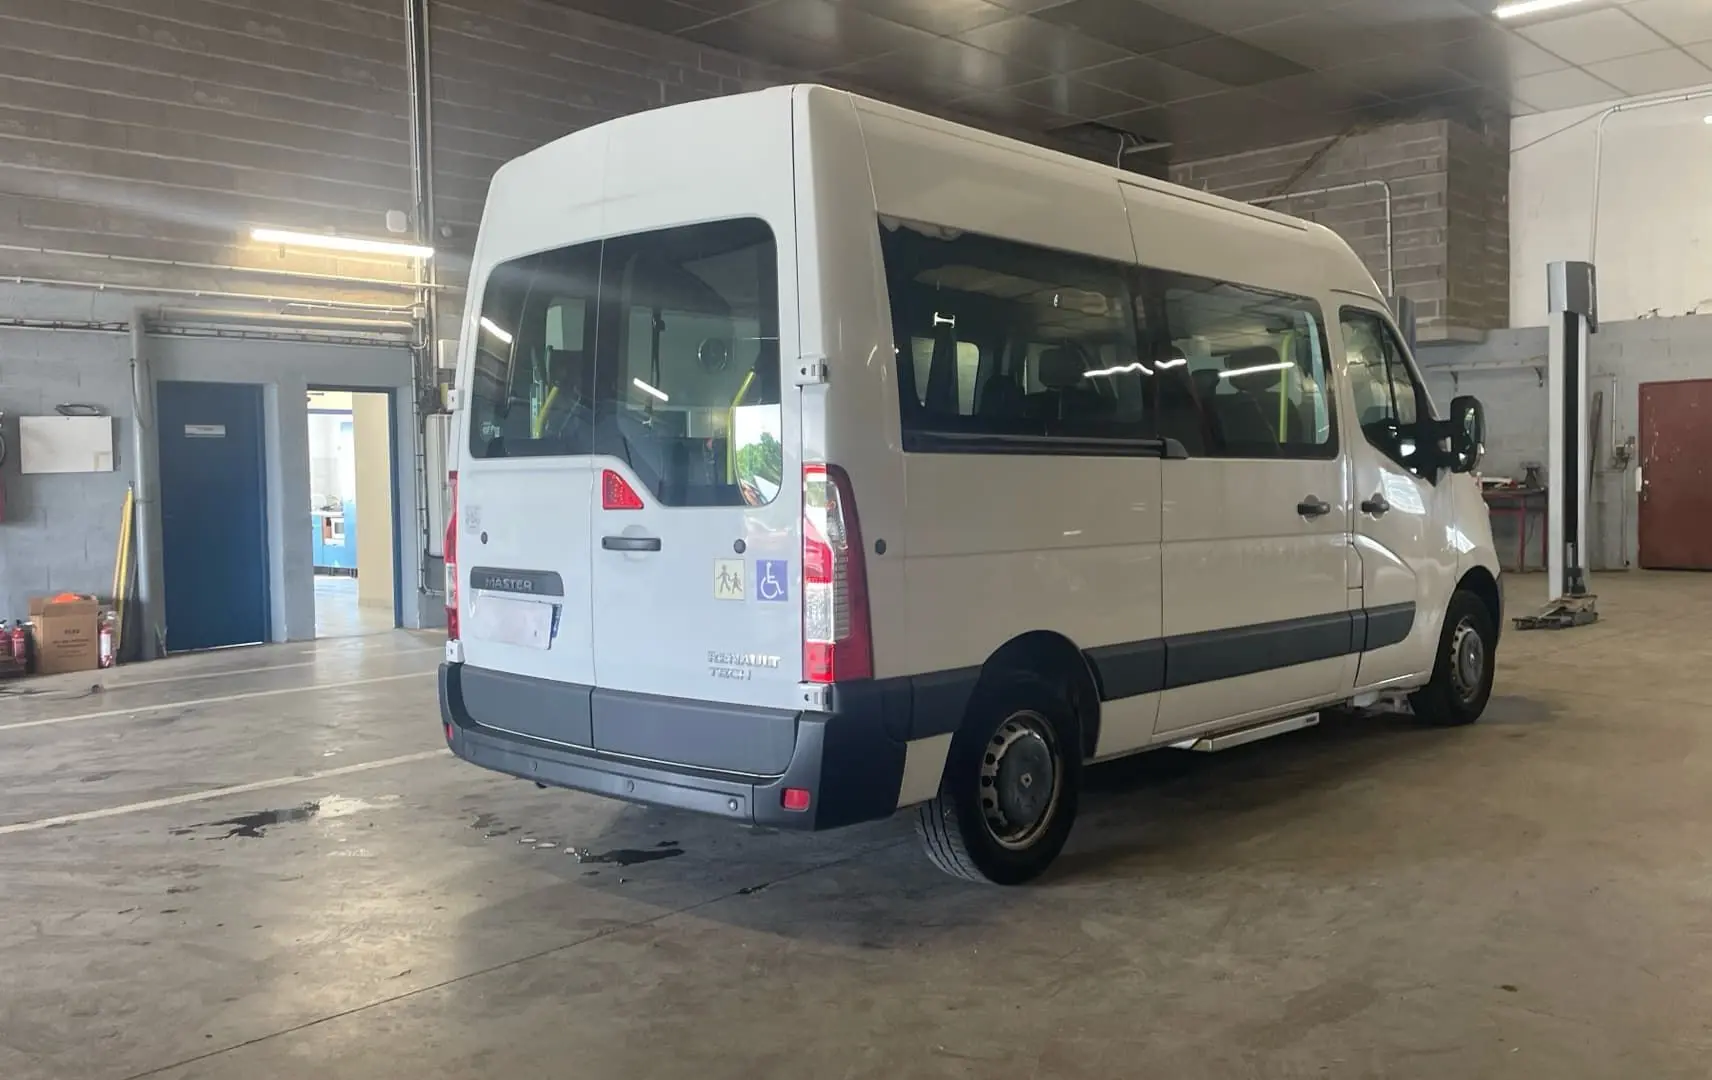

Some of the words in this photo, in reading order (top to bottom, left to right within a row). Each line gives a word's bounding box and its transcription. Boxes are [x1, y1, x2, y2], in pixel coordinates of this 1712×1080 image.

[484, 576, 535, 592] MASTER
[707, 650, 781, 668] RENAULT
[709, 666, 752, 681] TECH
